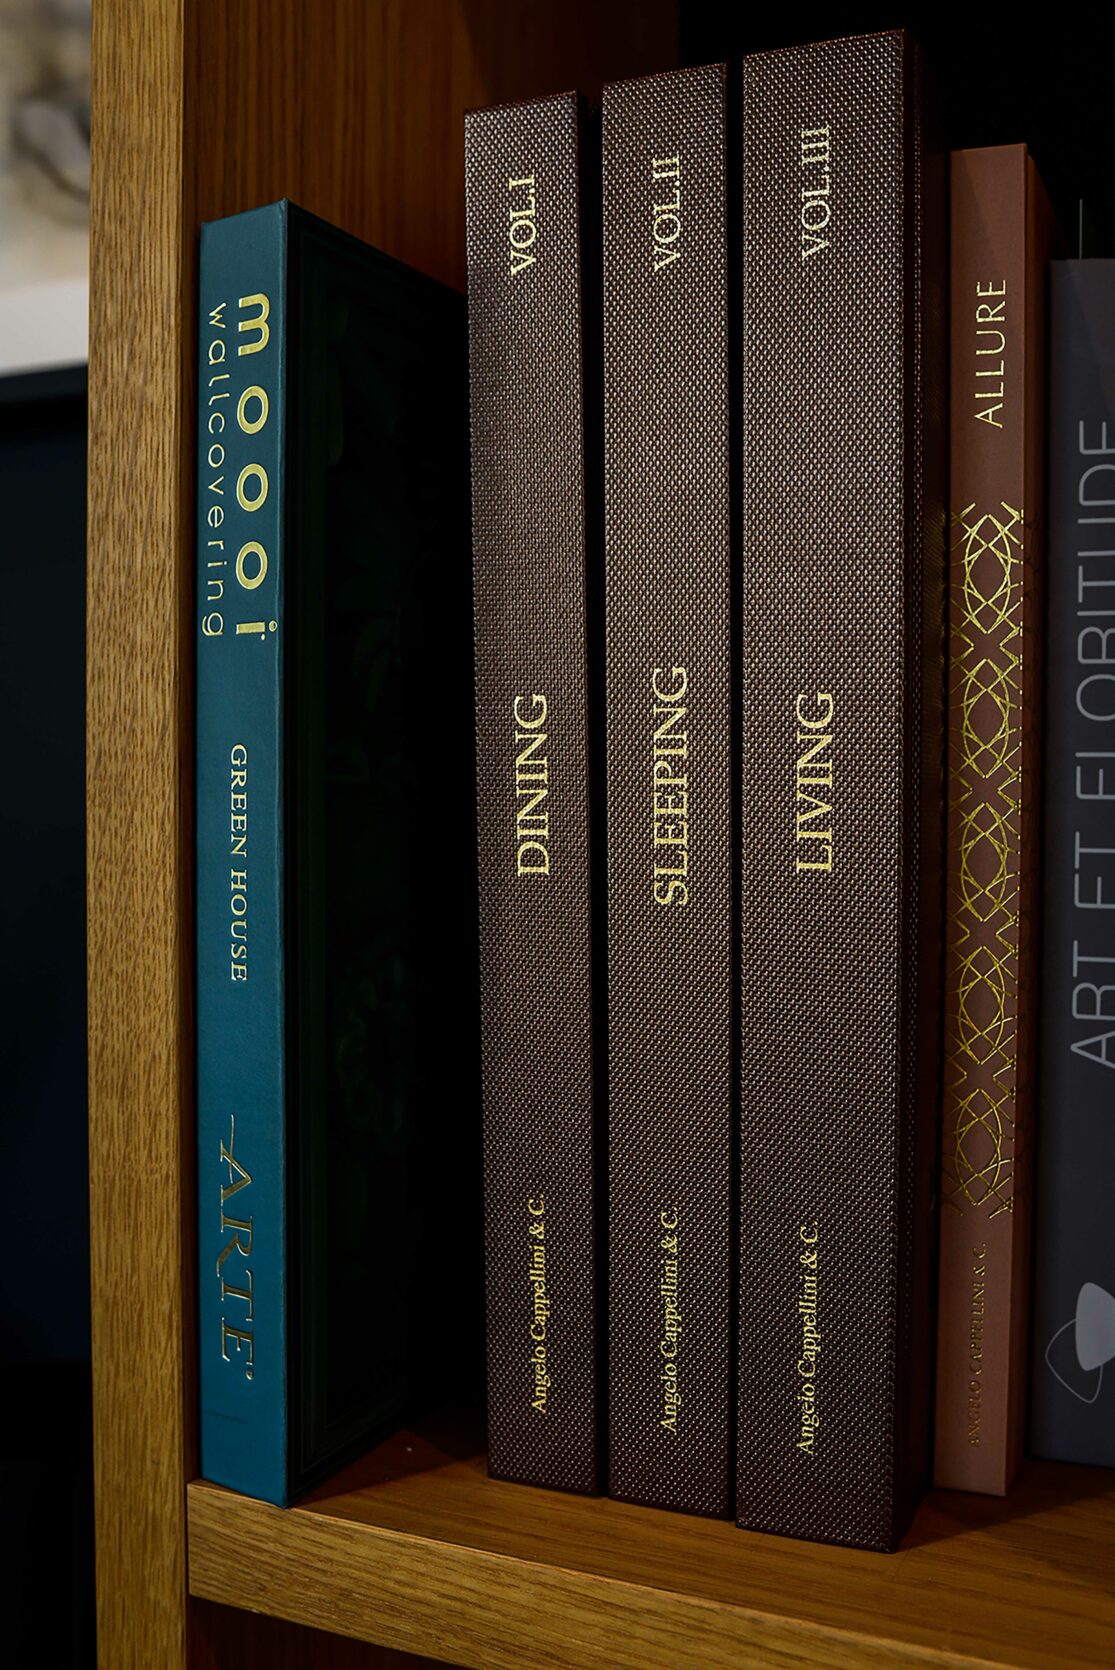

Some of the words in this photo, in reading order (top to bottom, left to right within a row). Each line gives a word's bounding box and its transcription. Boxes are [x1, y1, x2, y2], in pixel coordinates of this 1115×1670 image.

[507, 175, 540, 277] VOL.I
[651, 154, 682, 271] VOL.II
[799, 126, 831, 260] VOL.III
[974, 280, 1007, 428] ALLURE
[201, 302, 230, 638] wallcovering
[235, 293, 278, 640] moooi
[230, 744, 248, 858] GREEN
[514, 693, 550, 876] DINING
[652, 667, 689, 907] SLEEPING
[795, 692, 834, 872] LIVING
[230, 868, 248, 981] HOUSE
[1070, 940, 1115, 1070] ART
[529, 1222, 545, 1239] &
[660, 1235, 679, 1253] &
[799, 1250, 818, 1269] &
[971, 1264, 986, 1277] &
[529, 1245, 551, 1341] Cappellini
[659, 1259, 683, 1358] Cappellini
[797, 1276, 821, 1377] Cappellini
[968, 1281, 985, 1375] CAPPELLINI
[530, 1345, 551, 1413] Angelo
[659, 1362, 682, 1433] Angelo
[796, 1384, 820, 1455] Angelo
[967, 1380, 983, 1448] ANGELO
